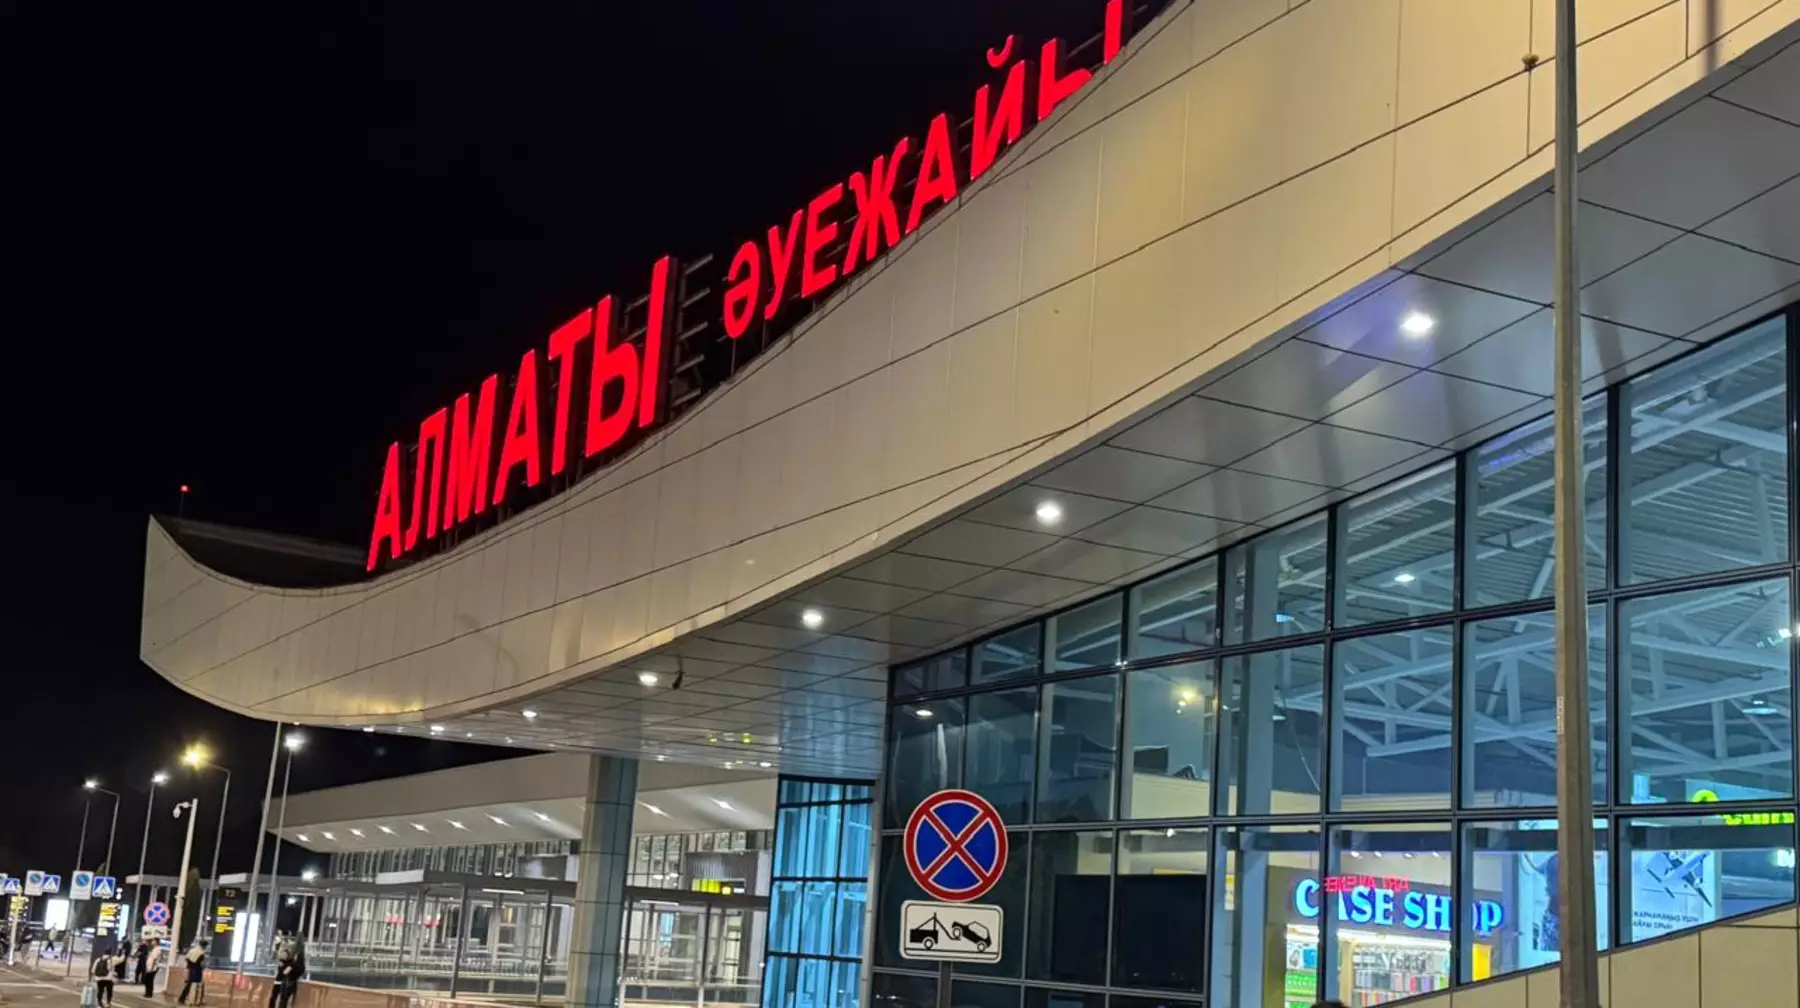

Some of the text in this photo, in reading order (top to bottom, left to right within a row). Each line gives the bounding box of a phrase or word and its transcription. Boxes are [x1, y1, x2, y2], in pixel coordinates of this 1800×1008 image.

[366, 0, 1125, 571] АЛМАТЫ ӘУЕЖАЙЫ
[1402, 890, 1503, 937] SHP
